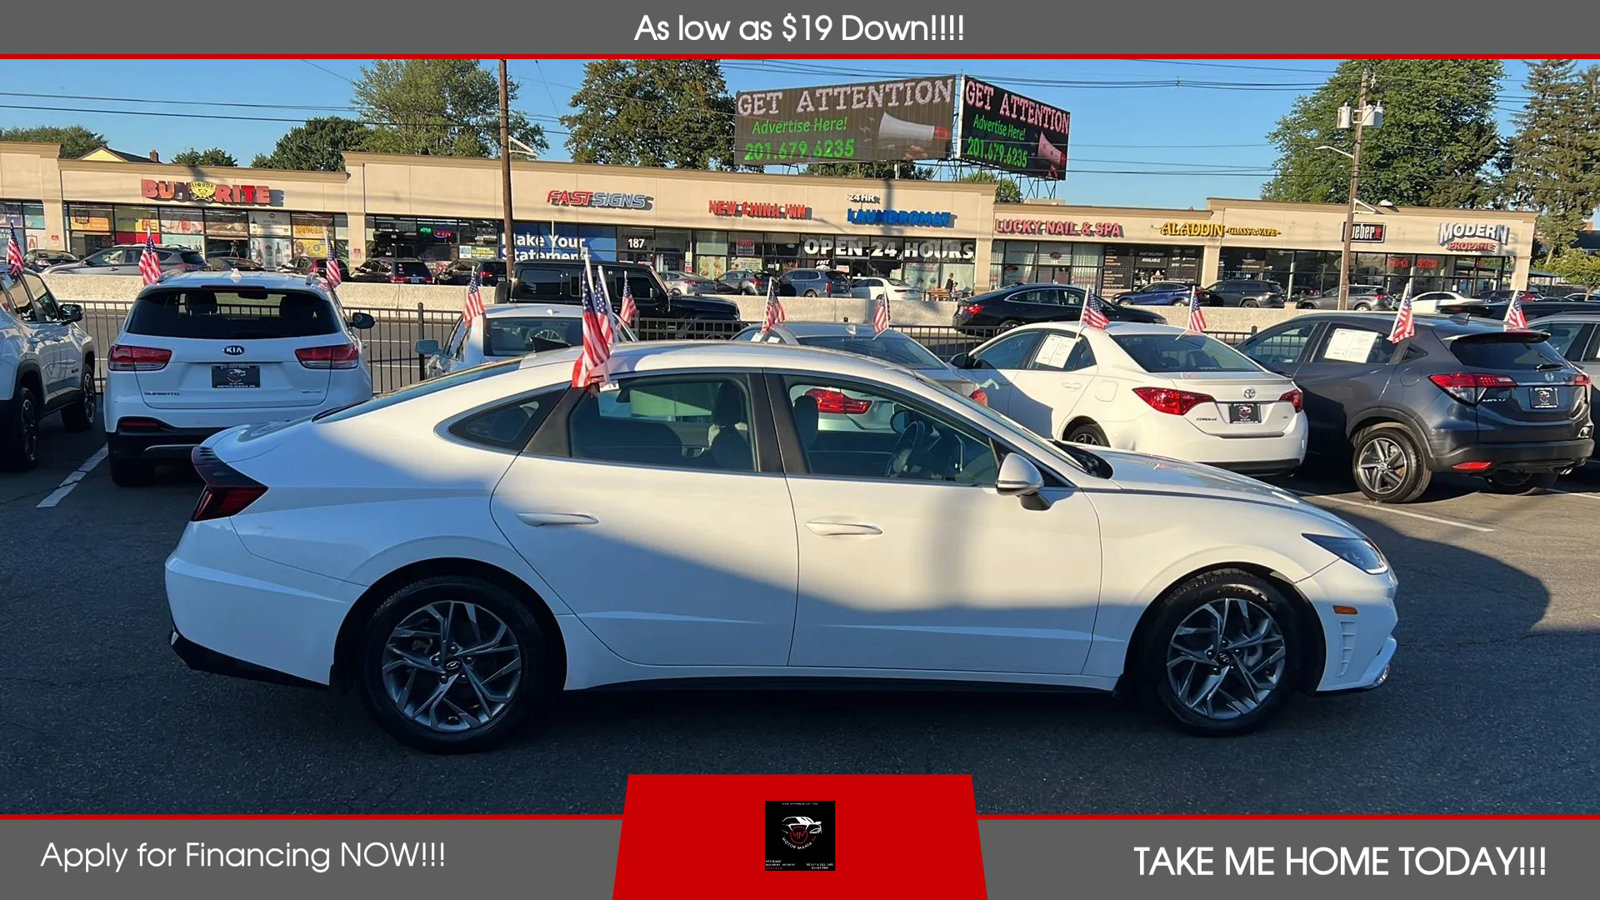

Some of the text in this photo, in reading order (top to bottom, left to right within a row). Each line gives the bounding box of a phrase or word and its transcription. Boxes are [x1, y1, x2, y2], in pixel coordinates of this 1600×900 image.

[737, 78, 954, 116] GET ATTENTION
[965, 80, 1070, 135] GET ATTENTION
[752, 116, 848, 135] Advertise Here!
[973, 114, 1026, 141] Advertise Here!
[744, 138, 856, 161] 201.6796235
[967, 136, 1028, 168] 201.679.6235
[215, 184, 270, 204] RITE
[547, 190, 646, 208] FASTSIGNS
[709, 199, 806, 218] NEW CHINA INN
[847, 207, 951, 227] LAUNDROMAT
[995, 218, 1121, 237] LUCKY NAIL & SPA
[1160, 222, 1225, 238] ALADDIN
[1438, 222, 1510, 245] MODERN
[549, 233, 586, 248] Your
[628, 238, 645, 249] 187
[803, 238, 974, 260] OPEN 24 HOURS
[1447, 241, 1496, 252] PROPANE
[501, 246, 591, 262] Statemen
[226, 346, 243, 354] KIA
